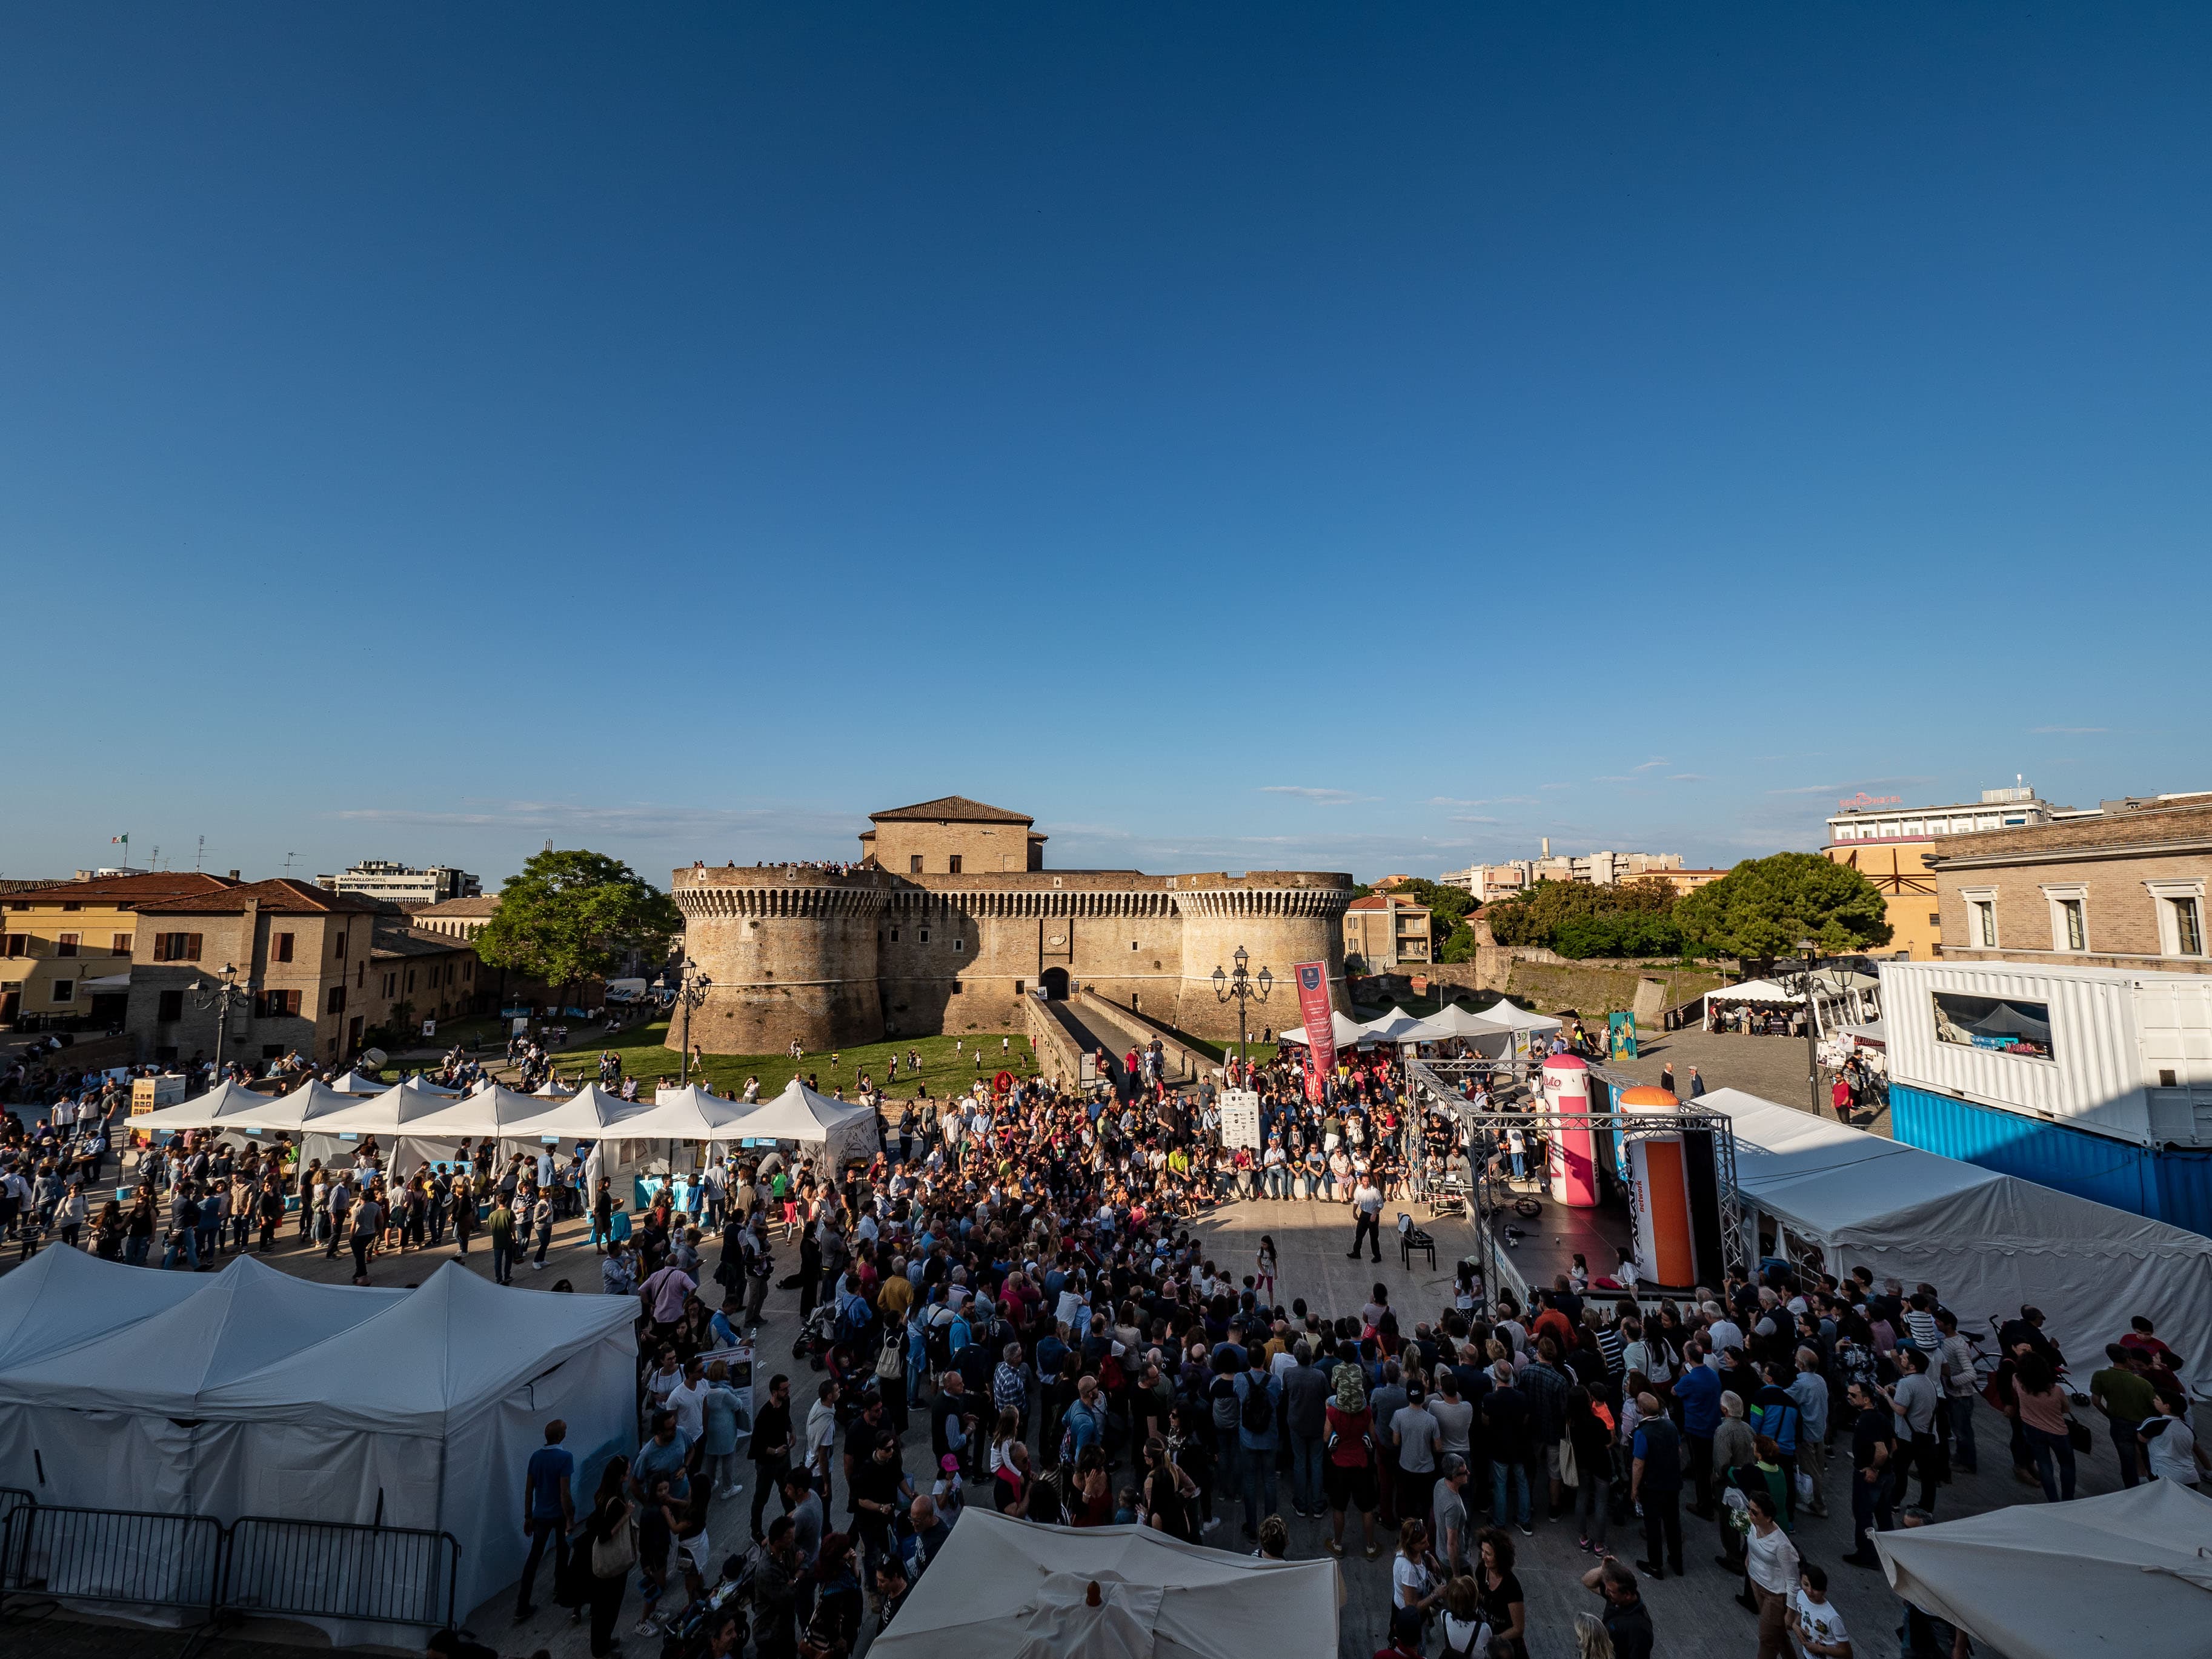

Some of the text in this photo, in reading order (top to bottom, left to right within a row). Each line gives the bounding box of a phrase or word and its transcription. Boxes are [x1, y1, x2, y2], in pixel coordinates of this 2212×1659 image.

[1516, 1032, 1527, 1042] 3D
[1543, 1075, 1561, 1087] luto
[1582, 1077, 1590, 1092] V
[1636, 1180, 1645, 1212] network
